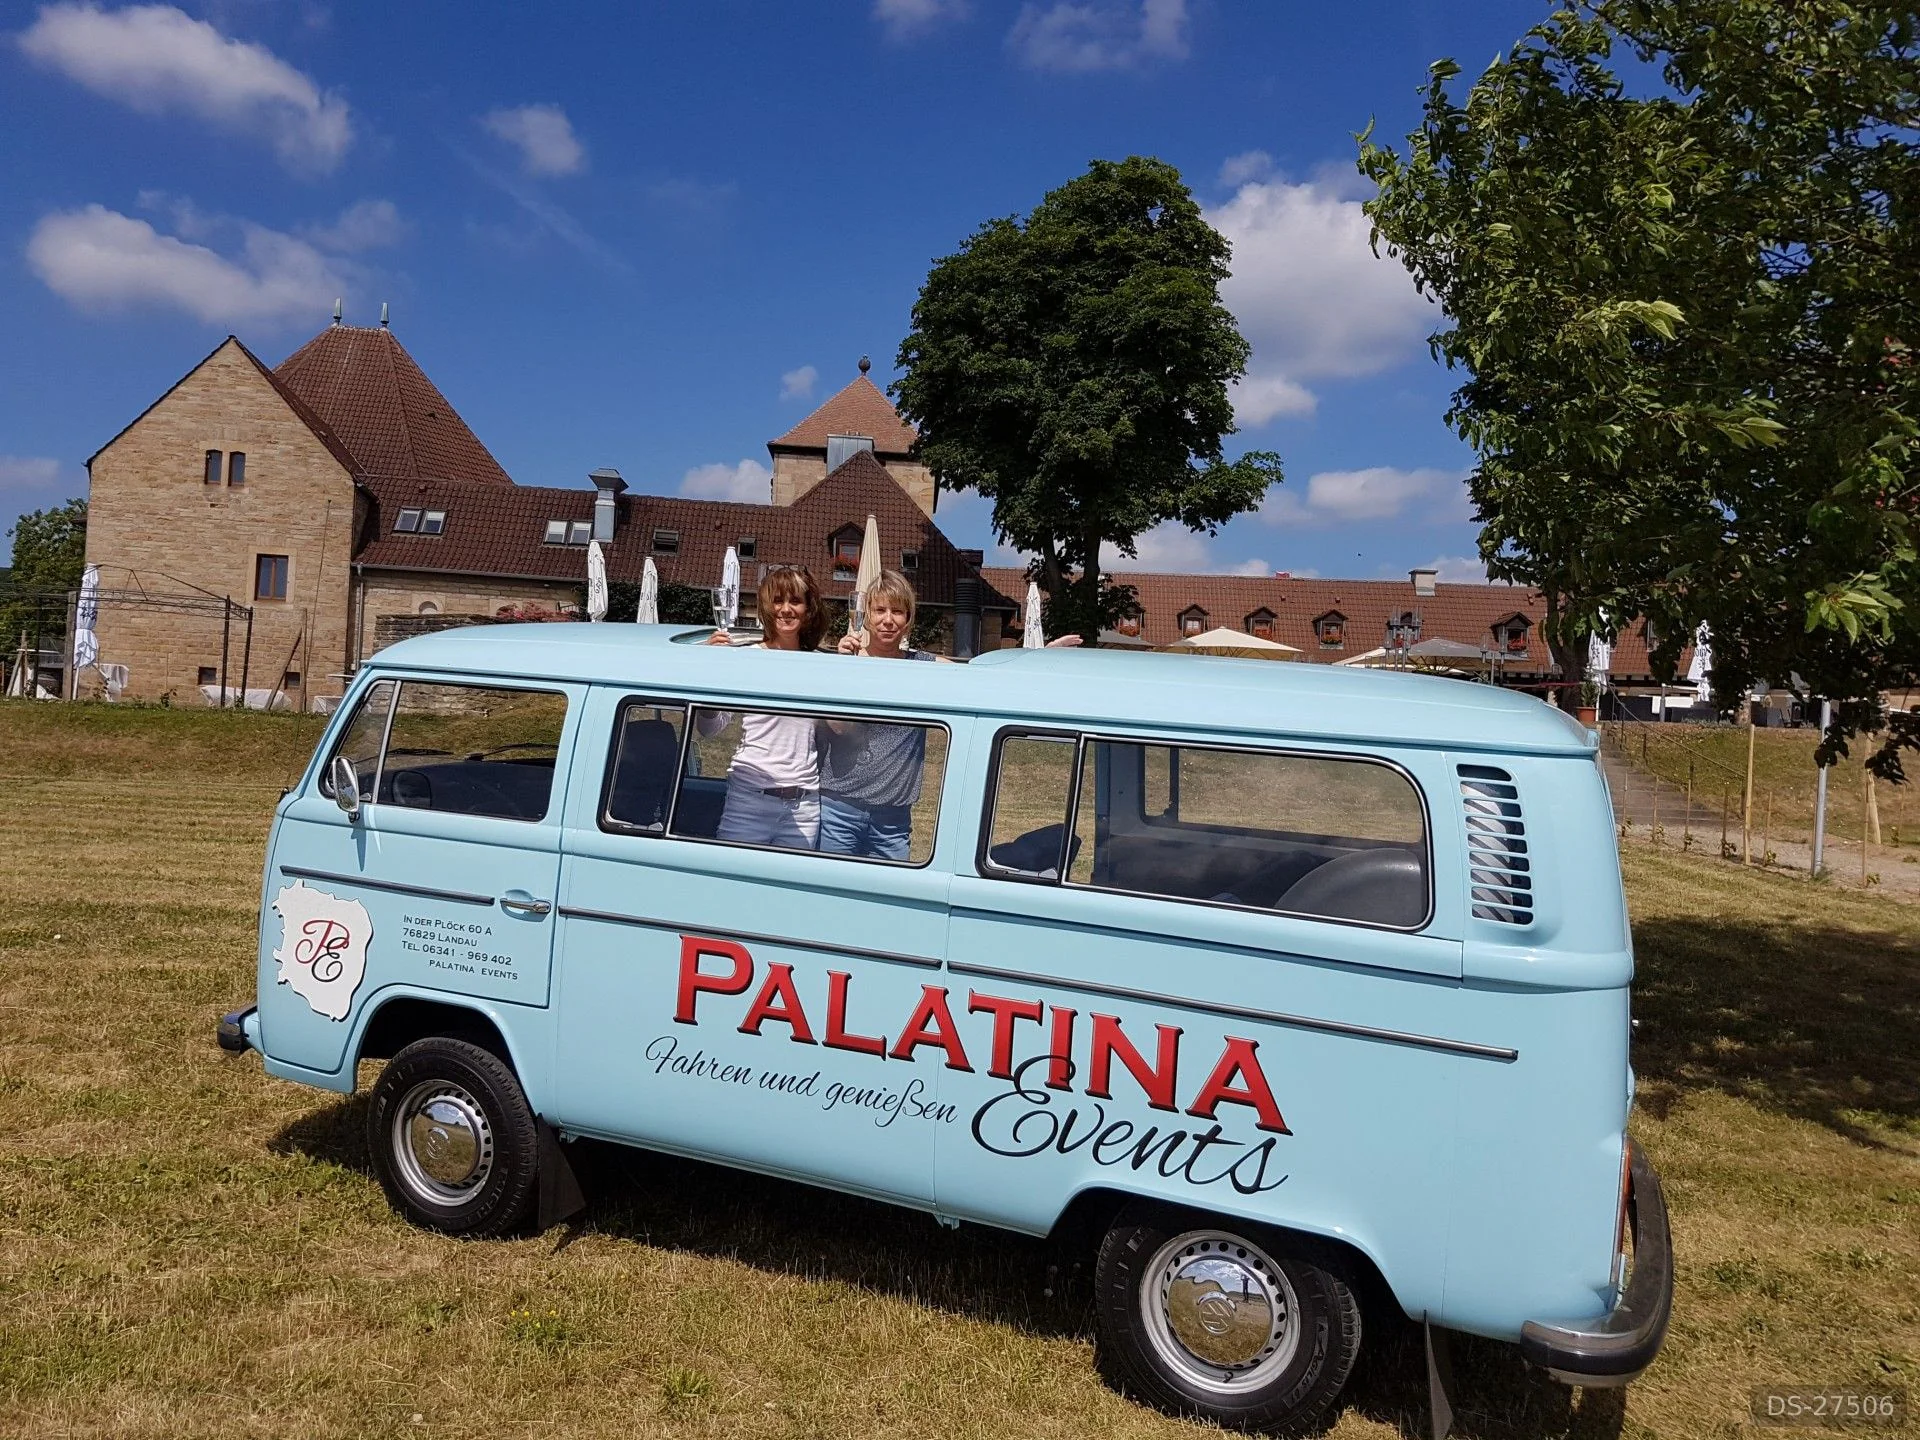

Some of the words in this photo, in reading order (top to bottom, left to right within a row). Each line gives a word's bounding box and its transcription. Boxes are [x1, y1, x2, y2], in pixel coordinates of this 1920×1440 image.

[402, 927, 436, 940] 76829
[437, 933, 478, 947] LANDAU
[468, 924, 483, 934] 60
[484, 927, 493, 936] A
[422, 943, 456, 957] 06341
[467, 950, 489, 962] 969
[490, 954, 512, 966] 402
[429, 959, 475, 974] PALATINA
[481, 967, 518, 981] EVENTS
[672, 933, 1294, 1136] PALATINA
[645, 1035, 755, 1086] Fahren
[758, 1070, 822, 1098] und
[821, 1078, 959, 1128] genießen
[971, 1054, 1289, 1195] Events
